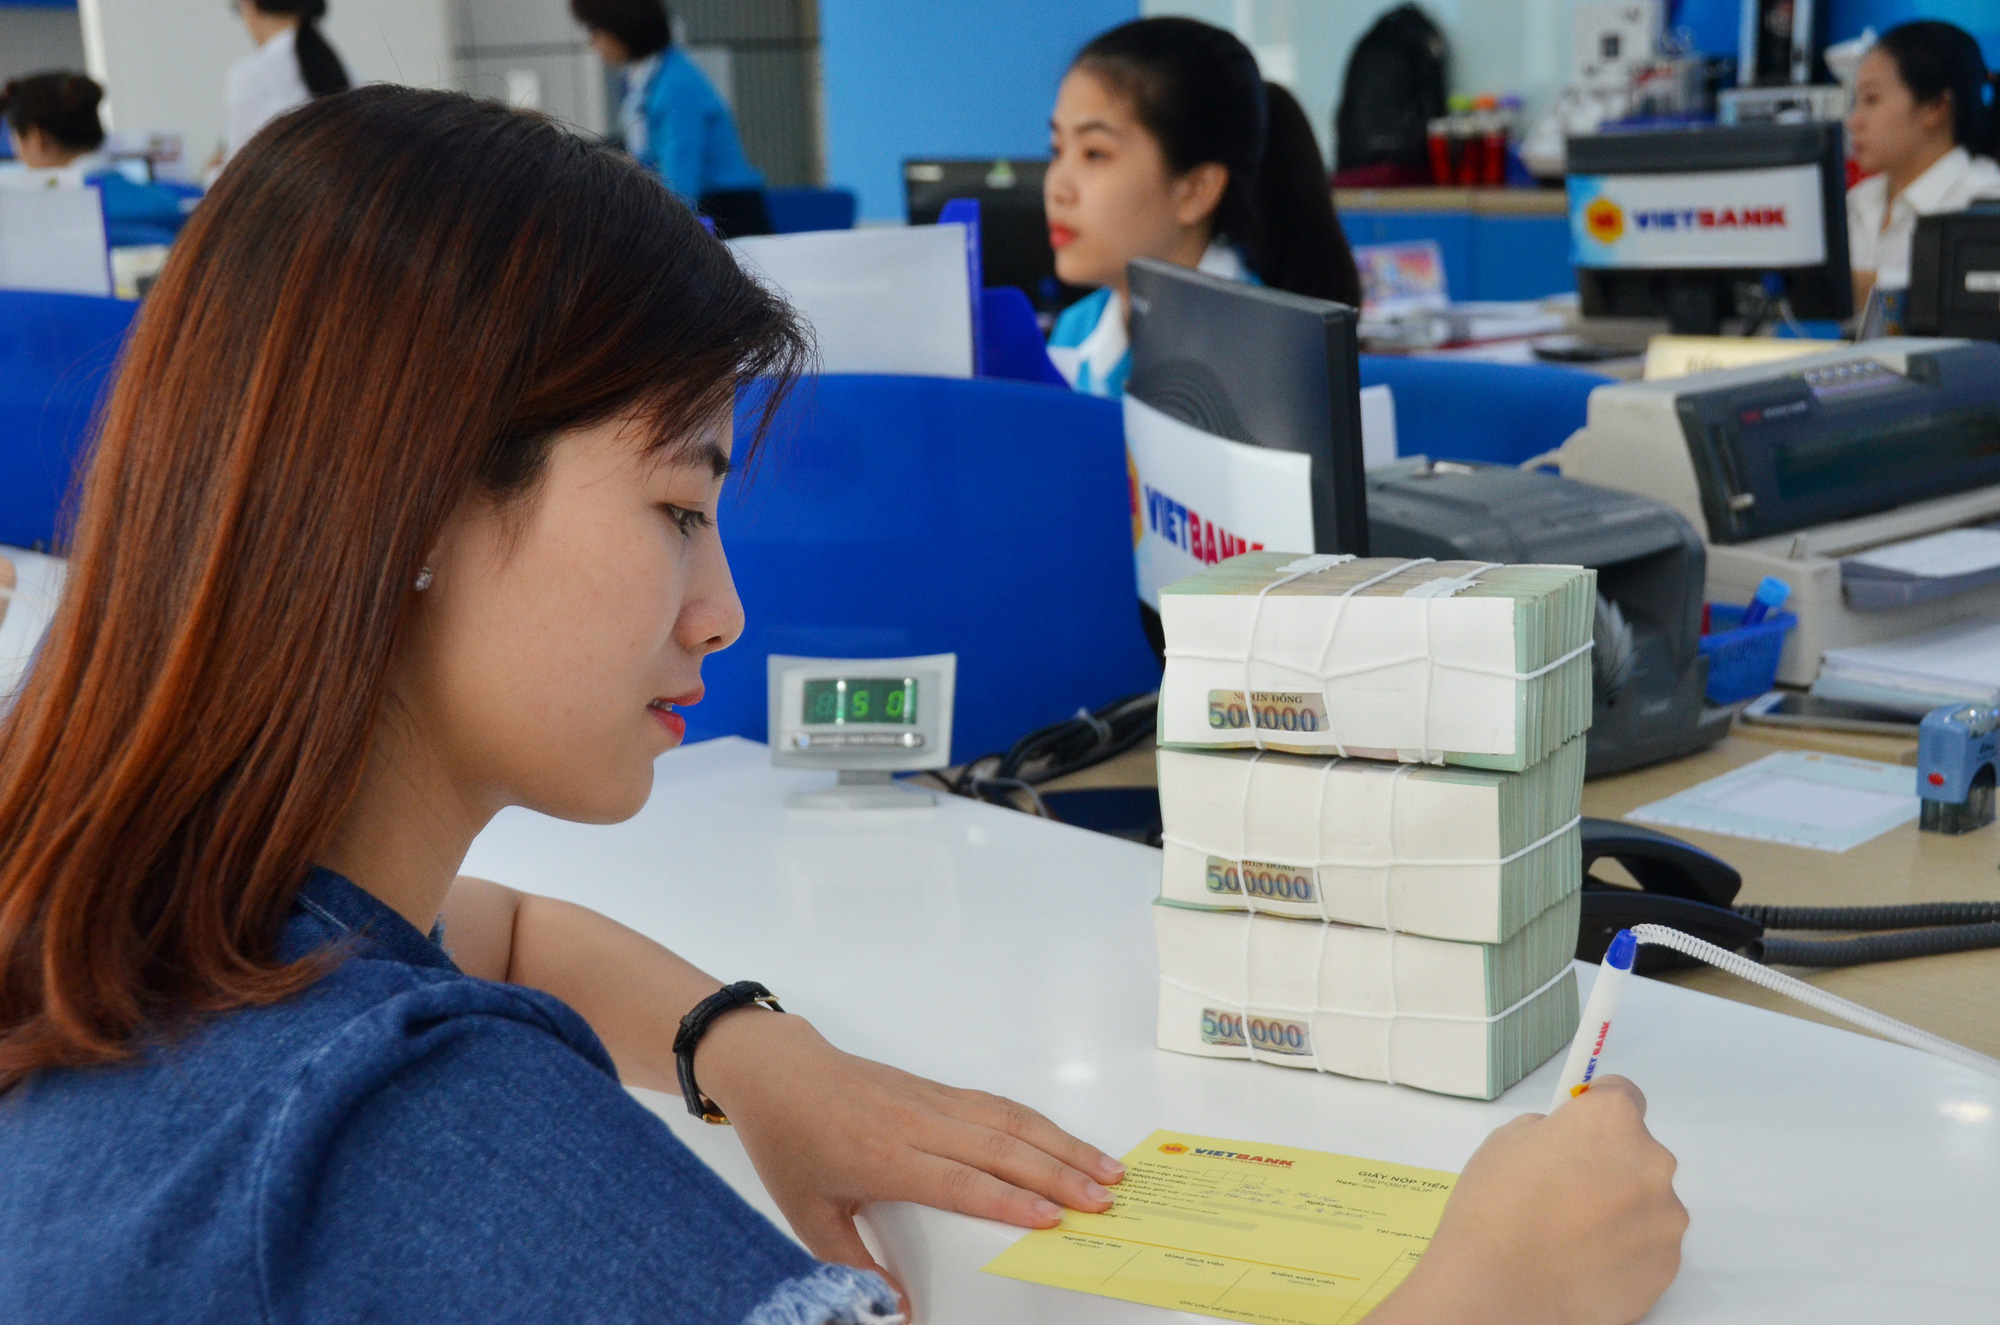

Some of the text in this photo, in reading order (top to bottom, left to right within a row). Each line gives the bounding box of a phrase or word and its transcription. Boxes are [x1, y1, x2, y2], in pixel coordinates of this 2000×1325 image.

[1633, 206, 1786, 231] VIETBANK
[1194, 1147, 1296, 1167] VIETBANK
[1358, 1170, 1389, 1180] GIẤY
[1390, 1175, 1418, 1185] NỘP
[1363, 1178, 1434, 1193] DEPOSIT SLIP
